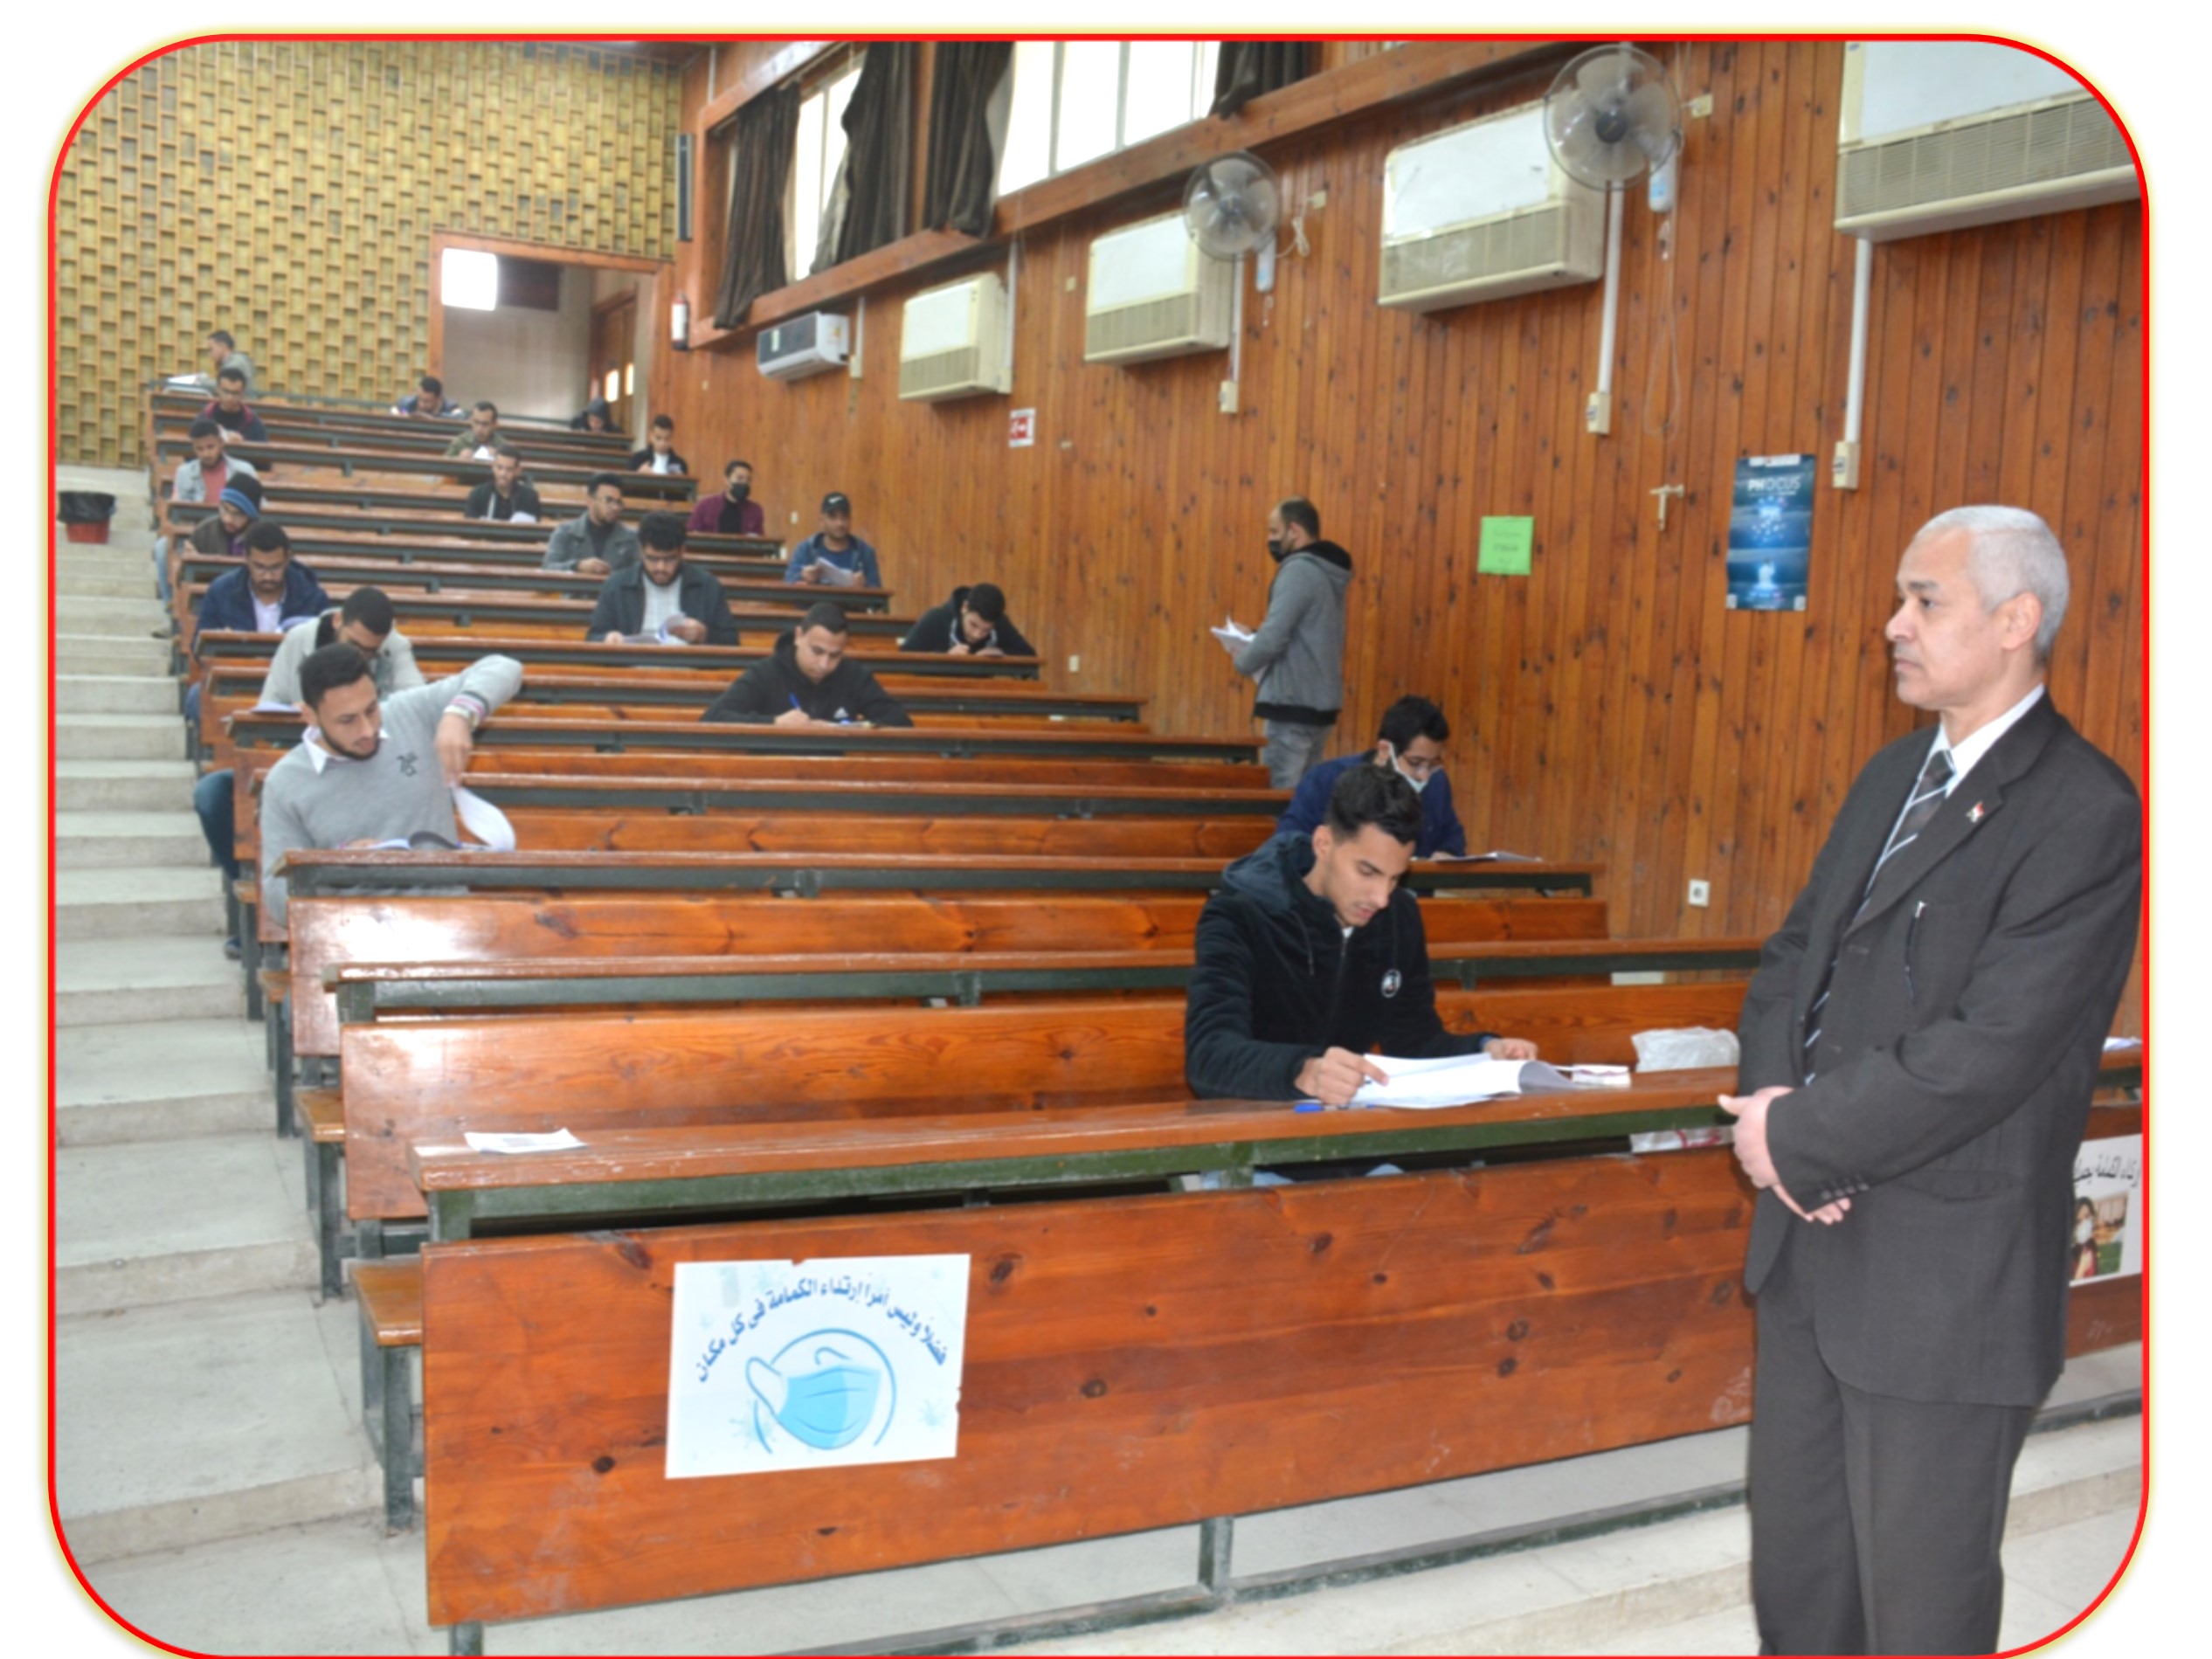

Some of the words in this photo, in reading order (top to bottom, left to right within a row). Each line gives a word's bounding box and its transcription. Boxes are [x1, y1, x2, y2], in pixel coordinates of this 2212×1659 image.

[765, 1277, 818, 1310] الكمامة
[728, 1311, 746, 1345] كل
[887, 1306, 922, 1337] وليس
[696, 1338, 727, 1383] مكان
